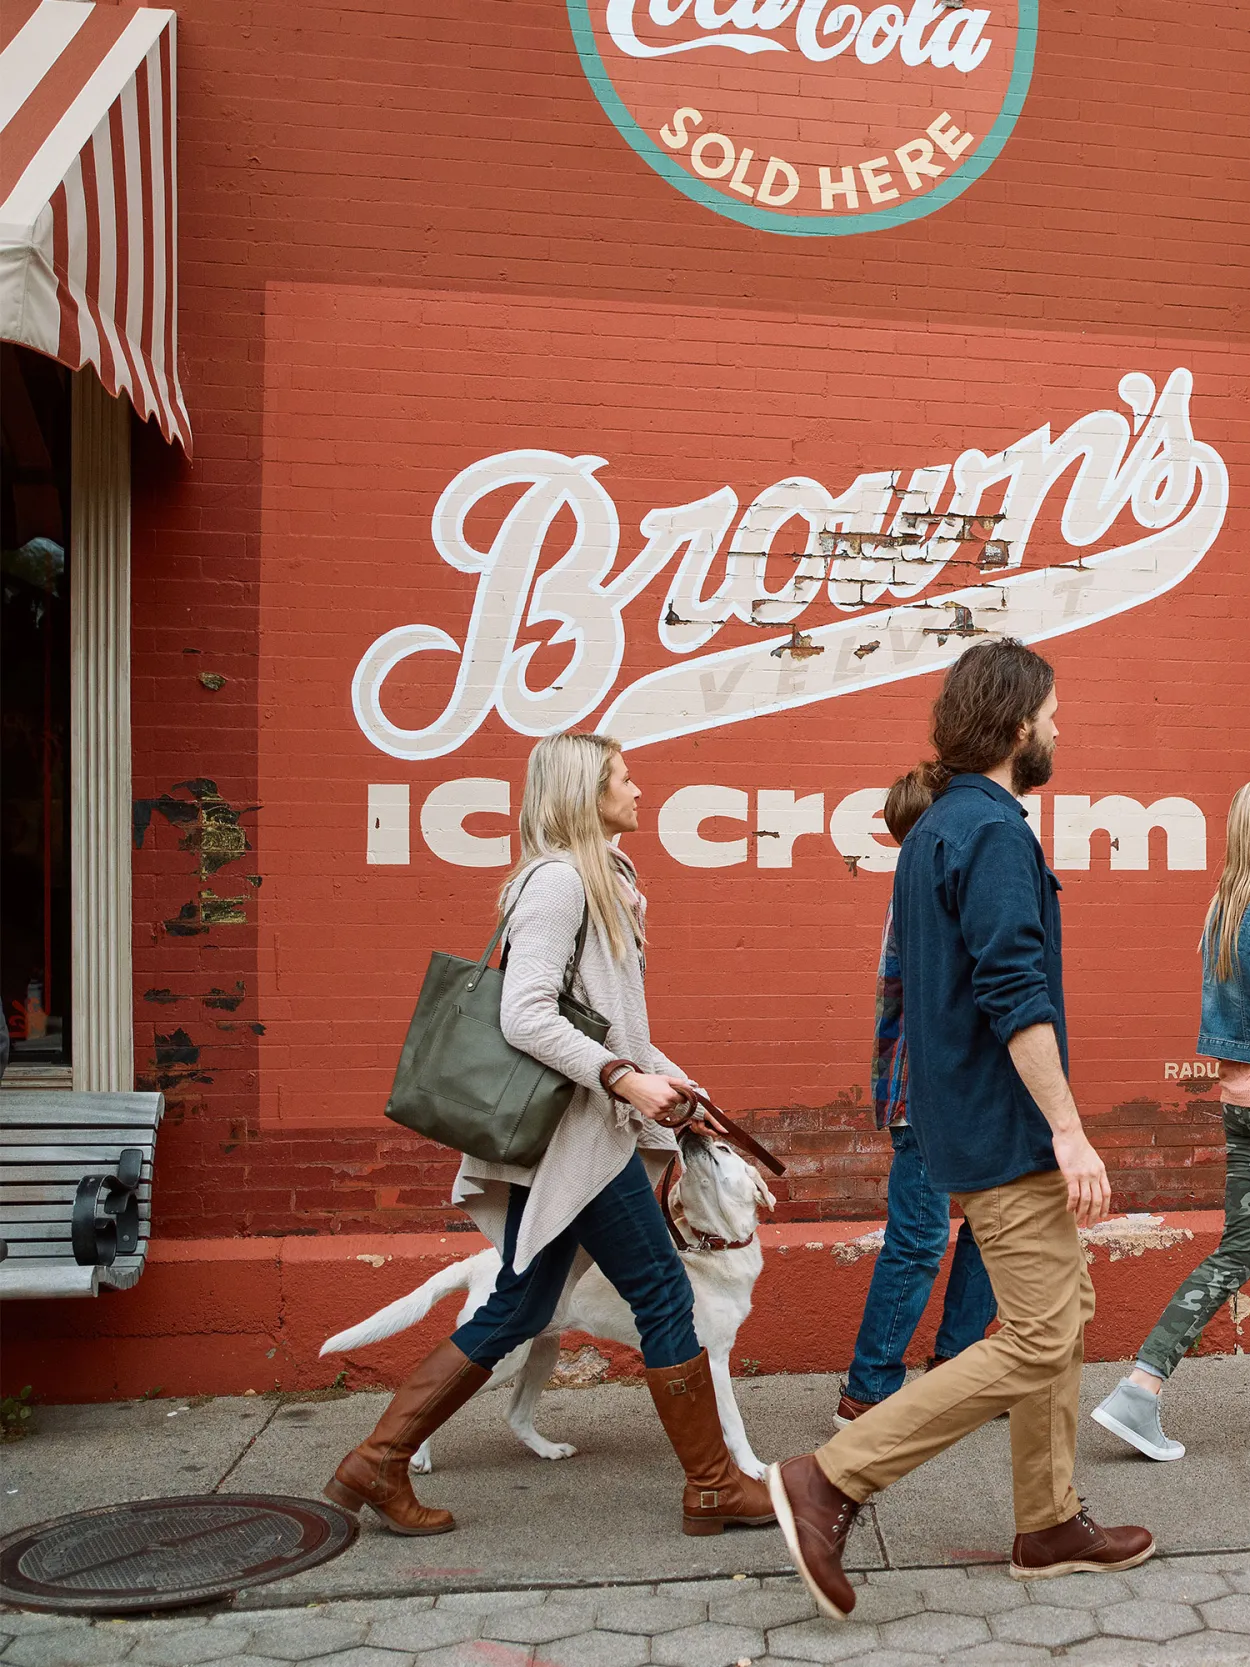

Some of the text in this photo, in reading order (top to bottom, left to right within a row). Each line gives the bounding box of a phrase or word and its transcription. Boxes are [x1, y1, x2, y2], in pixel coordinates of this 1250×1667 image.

[659, 107, 975, 210] SOLD HERE
[351, 366, 1230, 761] Brown's
[658, 785, 1207, 873] crem
